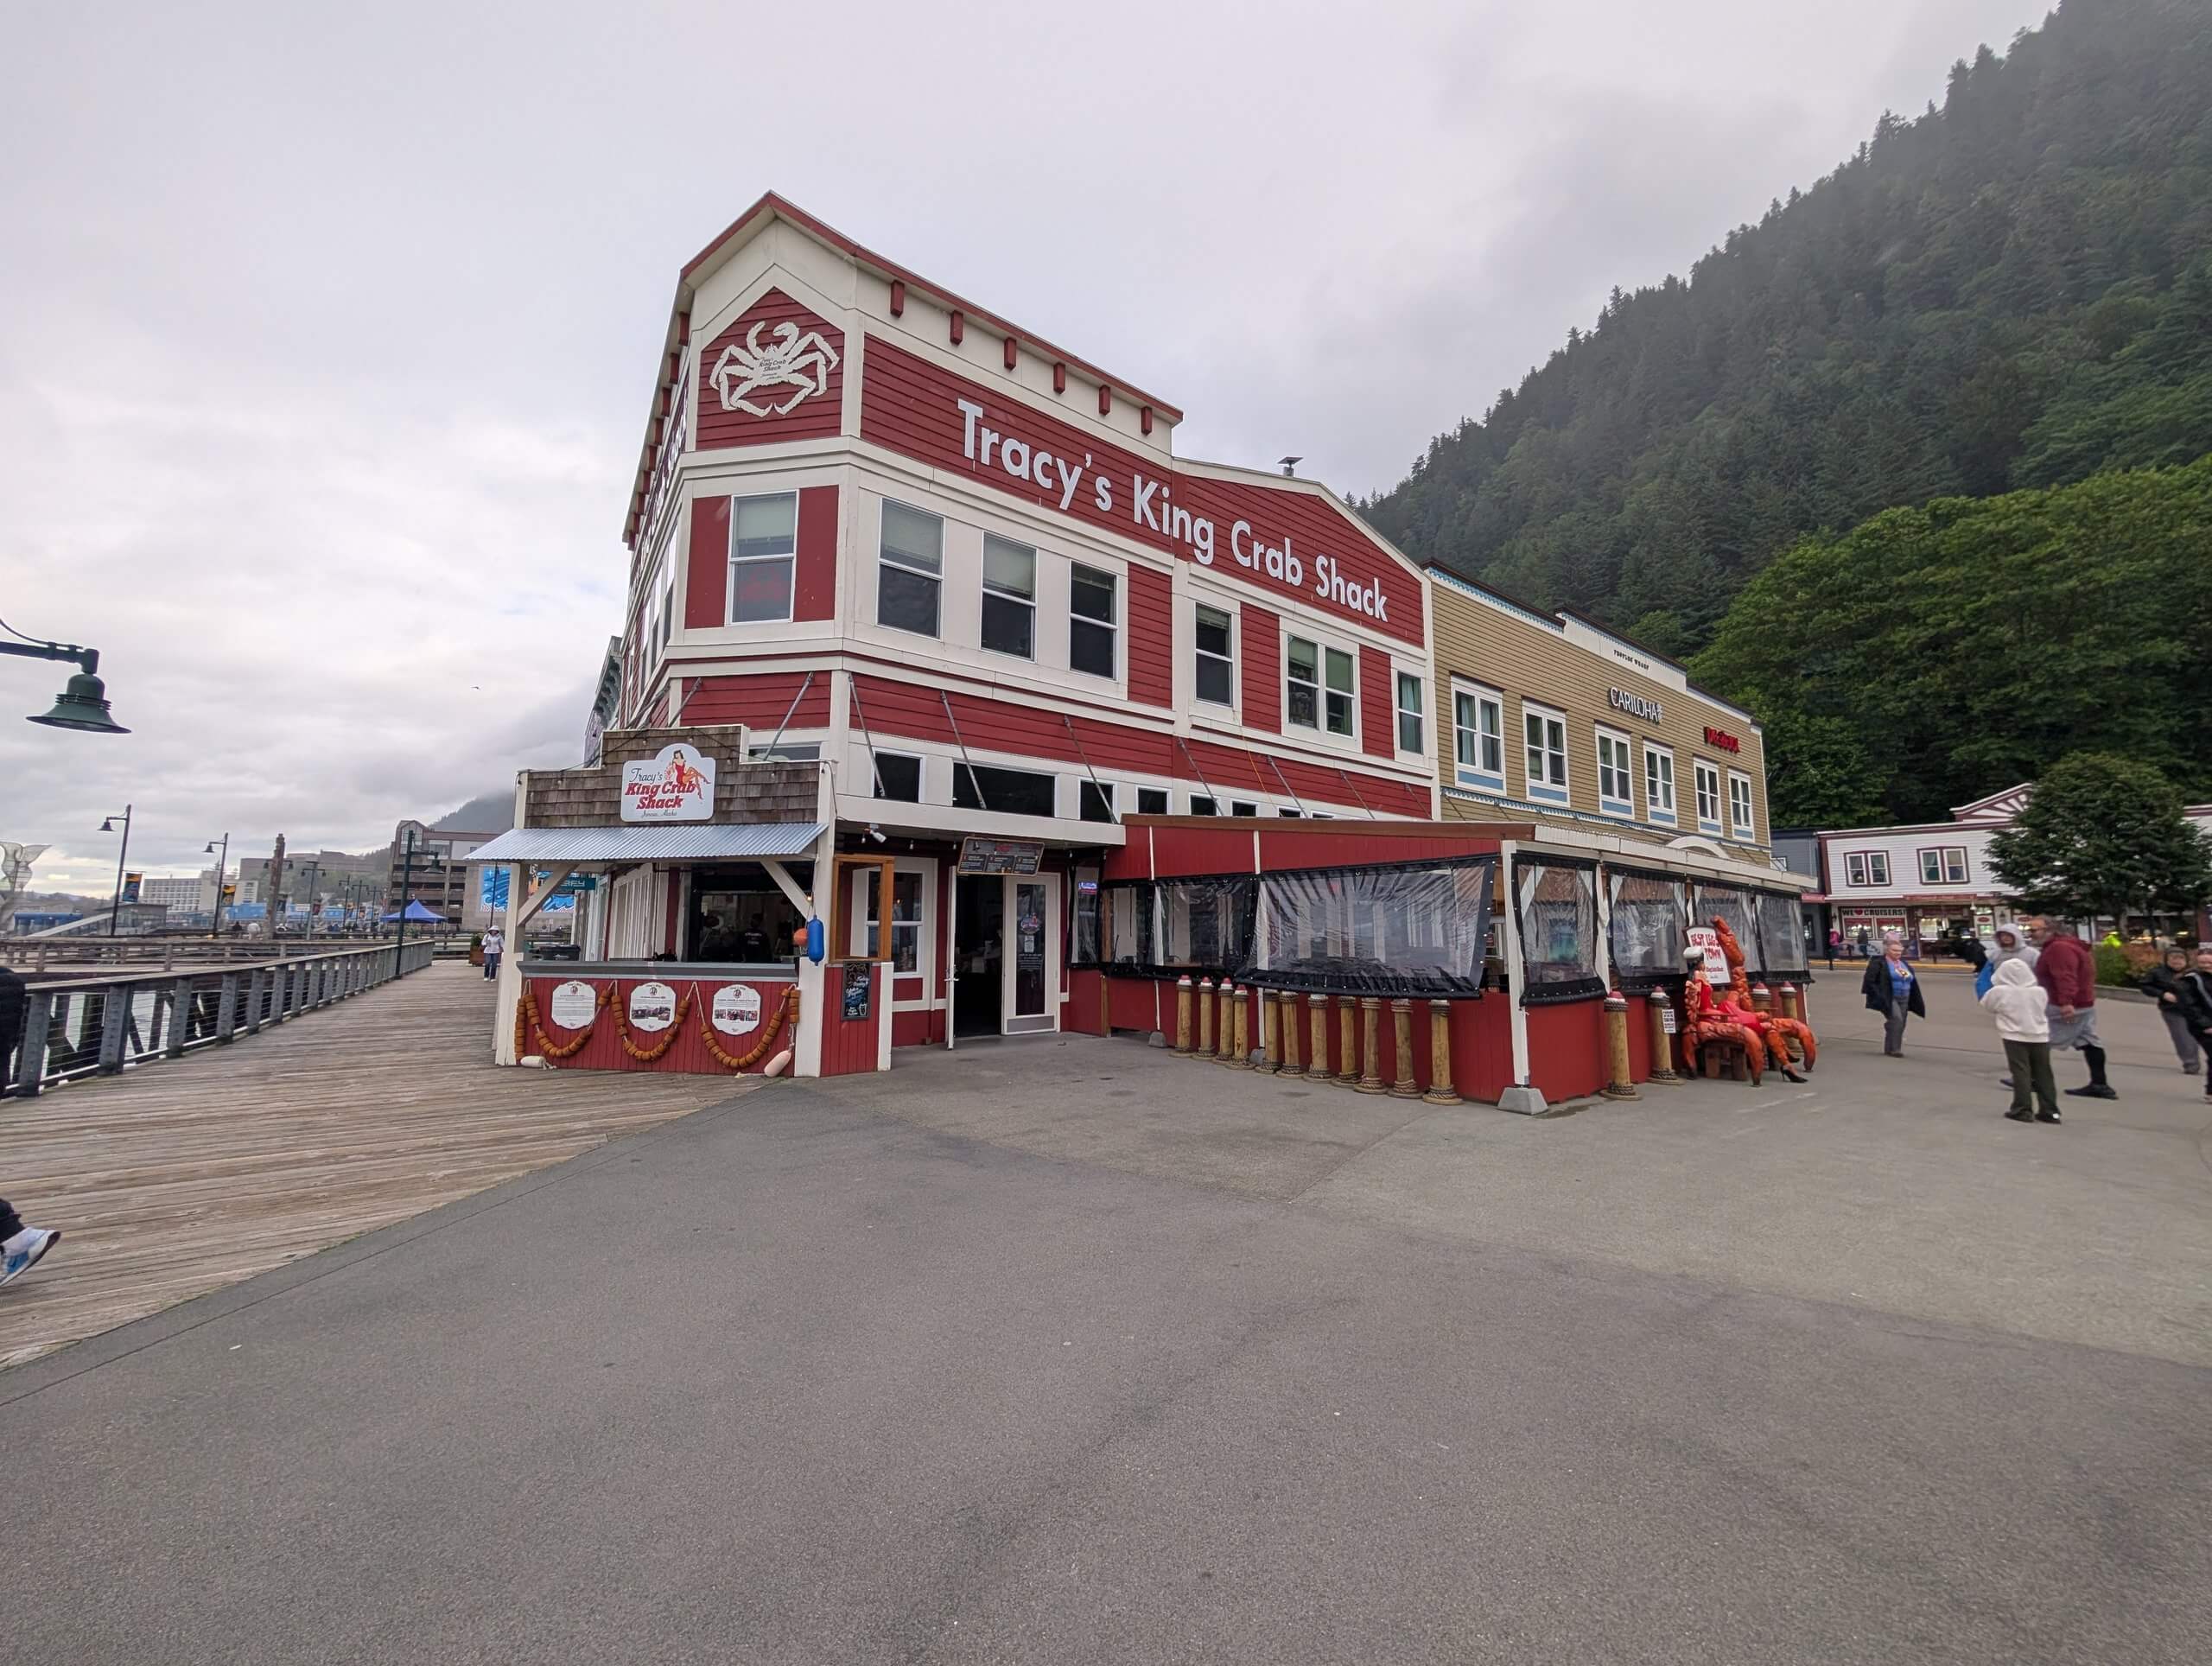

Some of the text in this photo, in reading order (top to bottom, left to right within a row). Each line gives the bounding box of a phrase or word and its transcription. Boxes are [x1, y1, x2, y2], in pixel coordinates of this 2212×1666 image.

[957, 398, 1389, 622] Tracy's King Crab Shack
[1610, 687, 1659, 722] CARILOHA
[629, 767, 663, 784] Tracy's
[625, 780, 696, 799] King Crab
[636, 795, 683, 810] Shack
